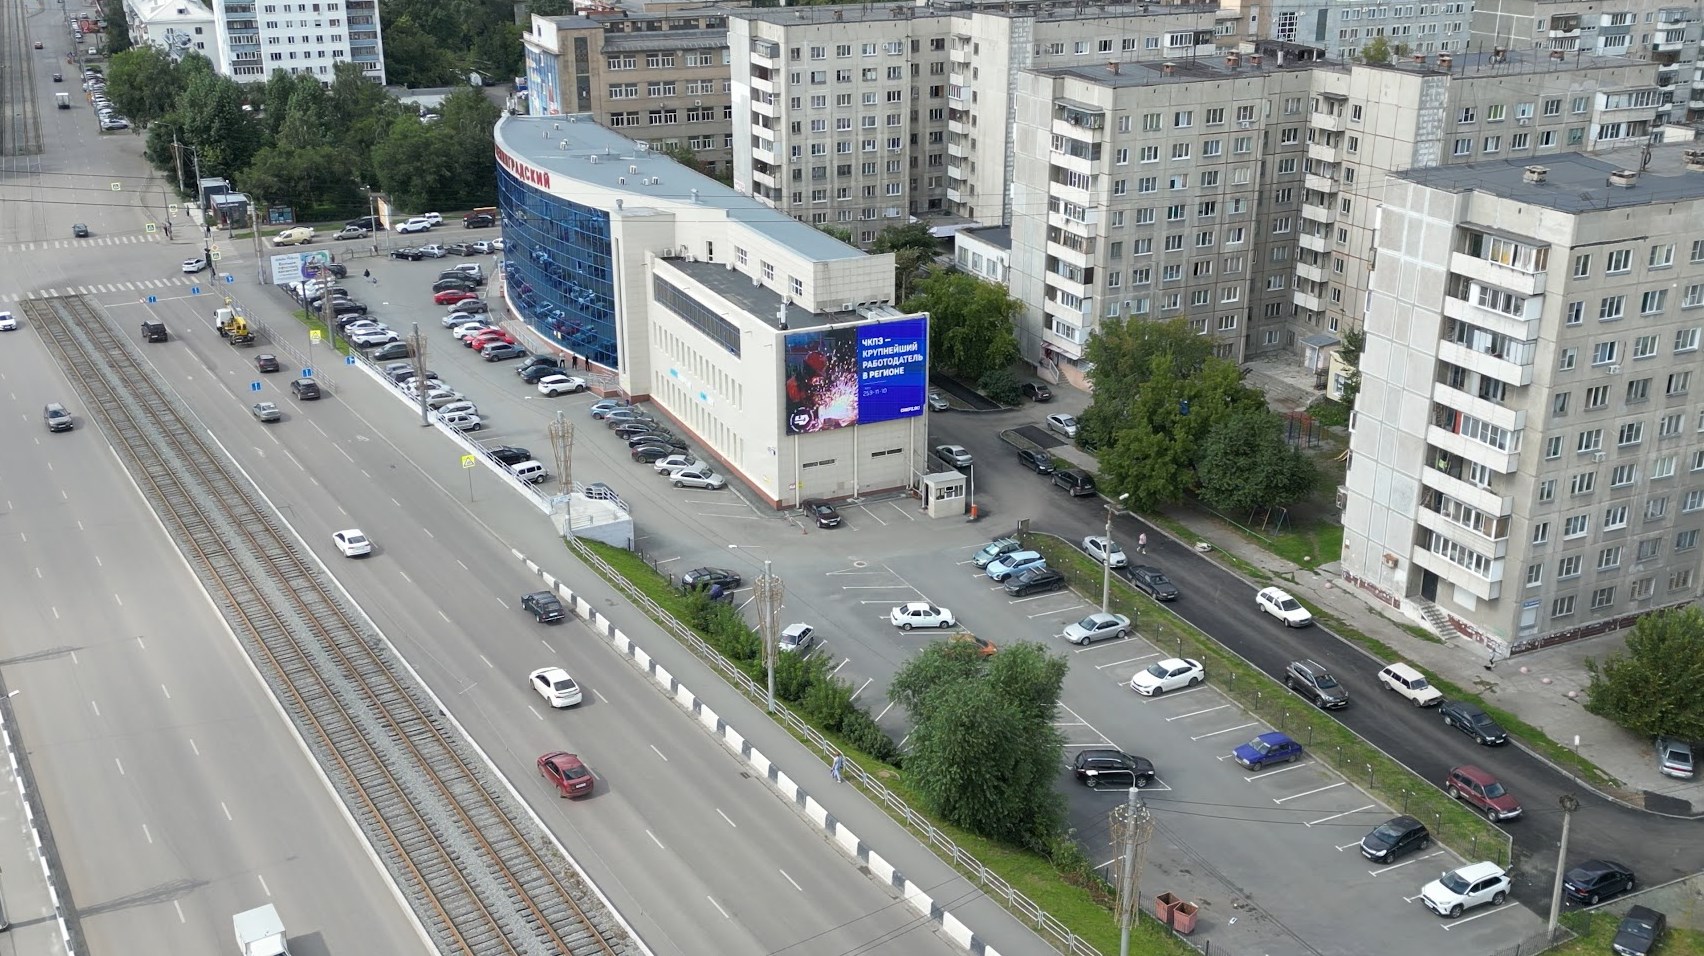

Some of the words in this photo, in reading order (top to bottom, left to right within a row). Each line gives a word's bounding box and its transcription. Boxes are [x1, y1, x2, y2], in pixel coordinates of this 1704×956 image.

[495, 144, 550, 189] ЕНИНГРАДСКИЙ
[862, 337, 883, 346] ЧКПЗ
[862, 342, 917, 358] КРУПНЕЙШИЙ
[862, 354, 924, 369] РАБОТОДАТЕЛЬ
[869, 367, 904, 378] РЕГИОНЕ
